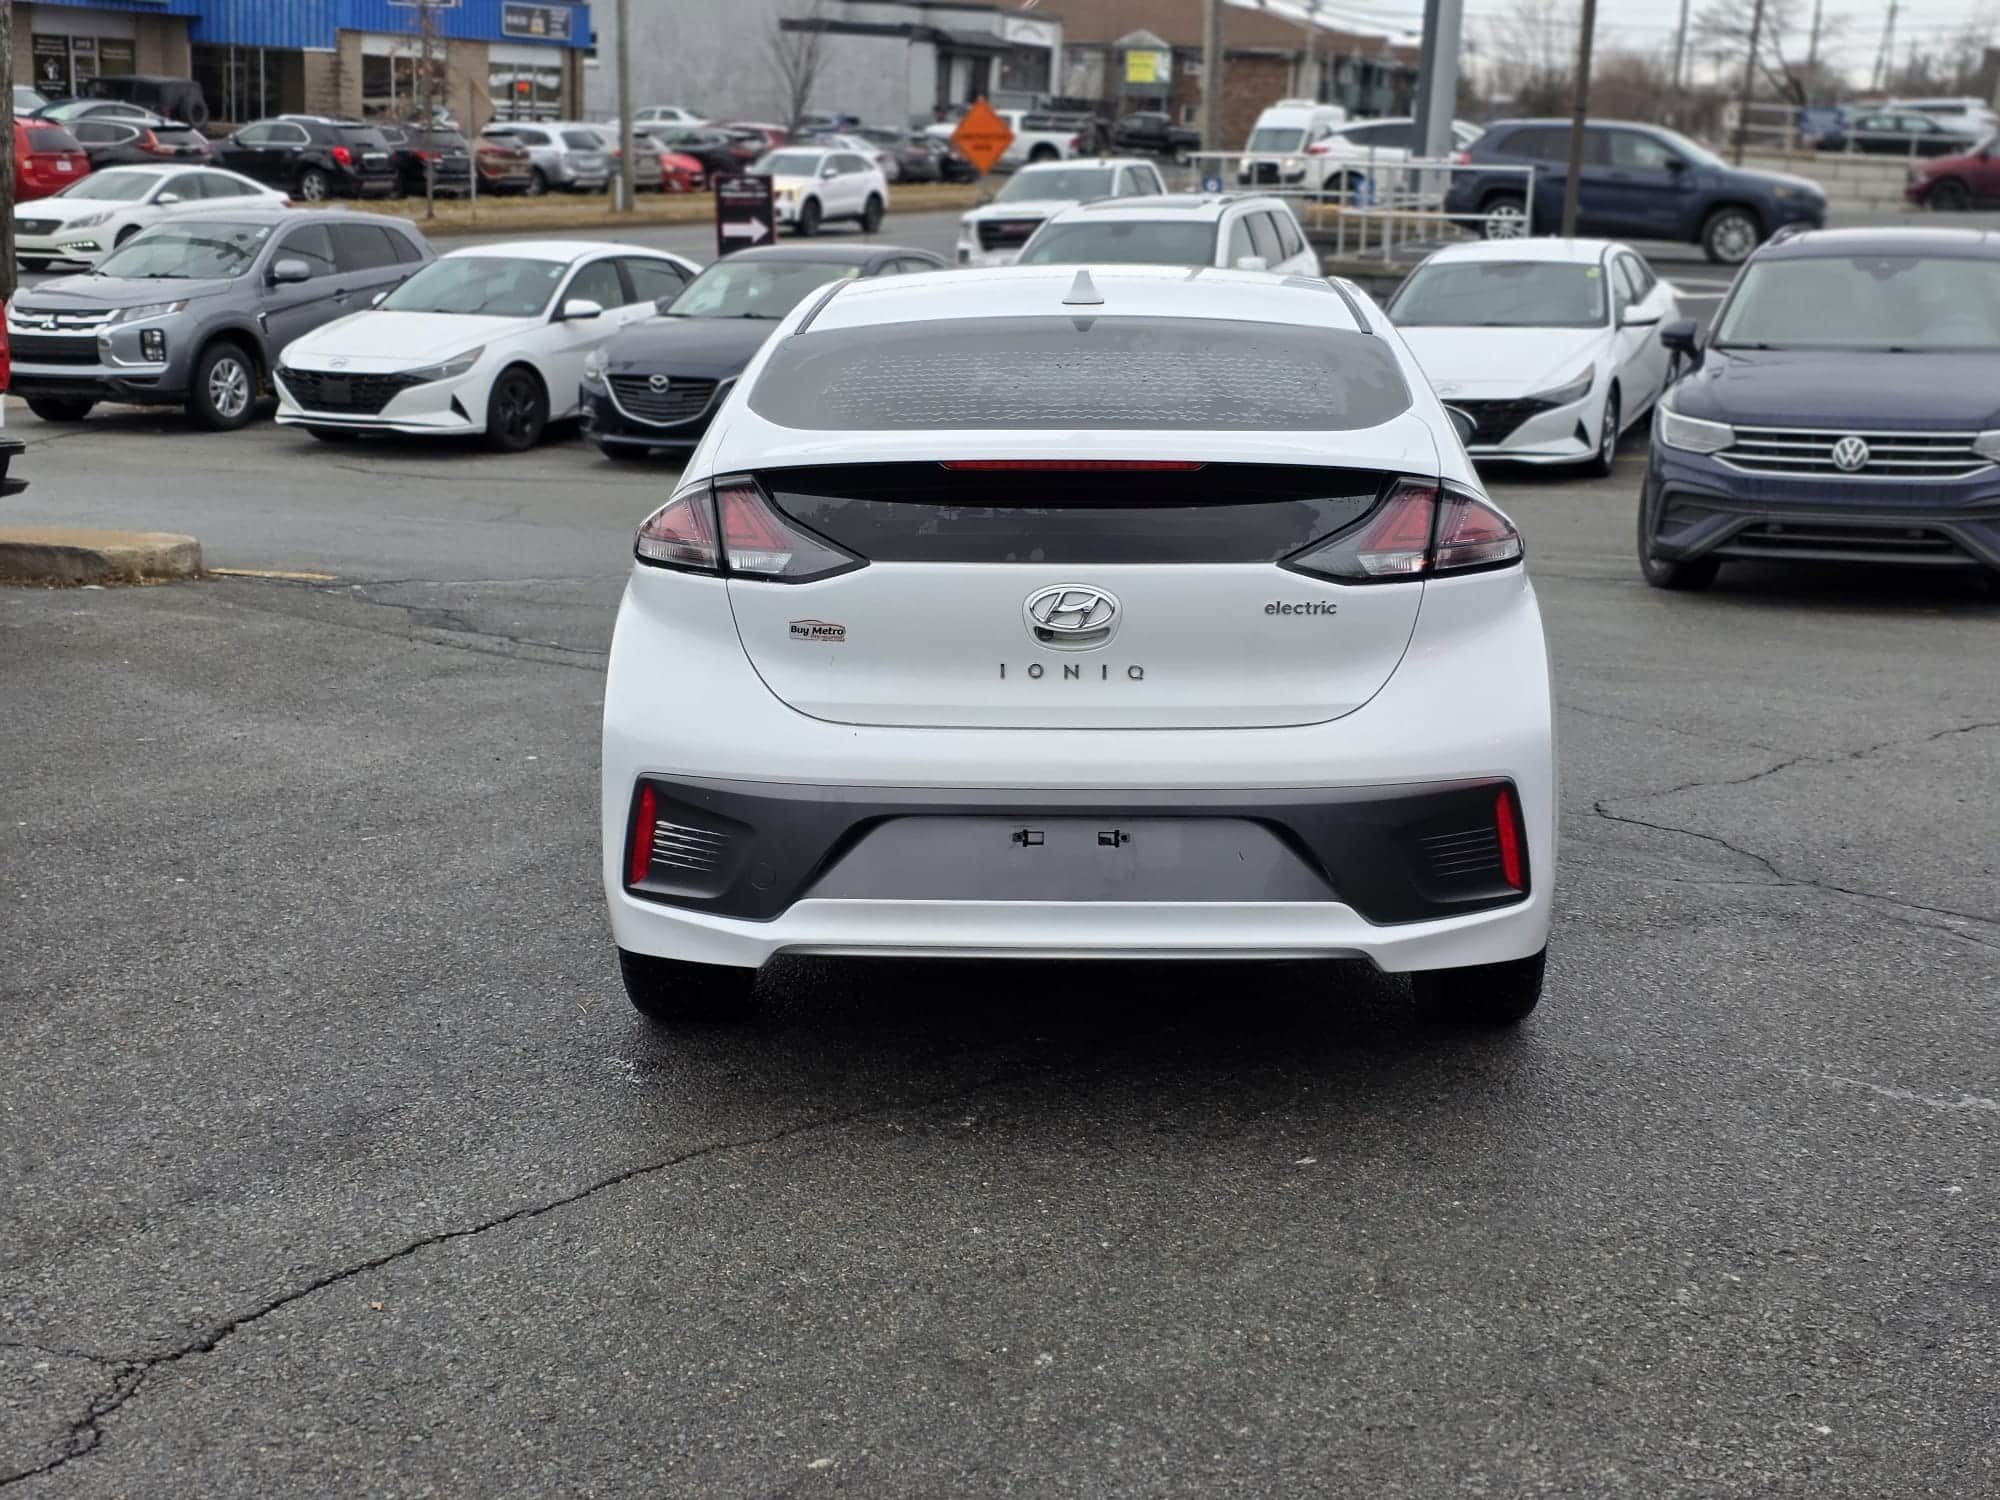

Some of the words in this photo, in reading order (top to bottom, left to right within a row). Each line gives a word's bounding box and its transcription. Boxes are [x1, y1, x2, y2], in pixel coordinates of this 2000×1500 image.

[1264, 600, 1337, 615] electric
[790, 625, 810, 637] Buy
[812, 626, 844, 635] Metro
[1000, 663, 1145, 681] IONIQ
